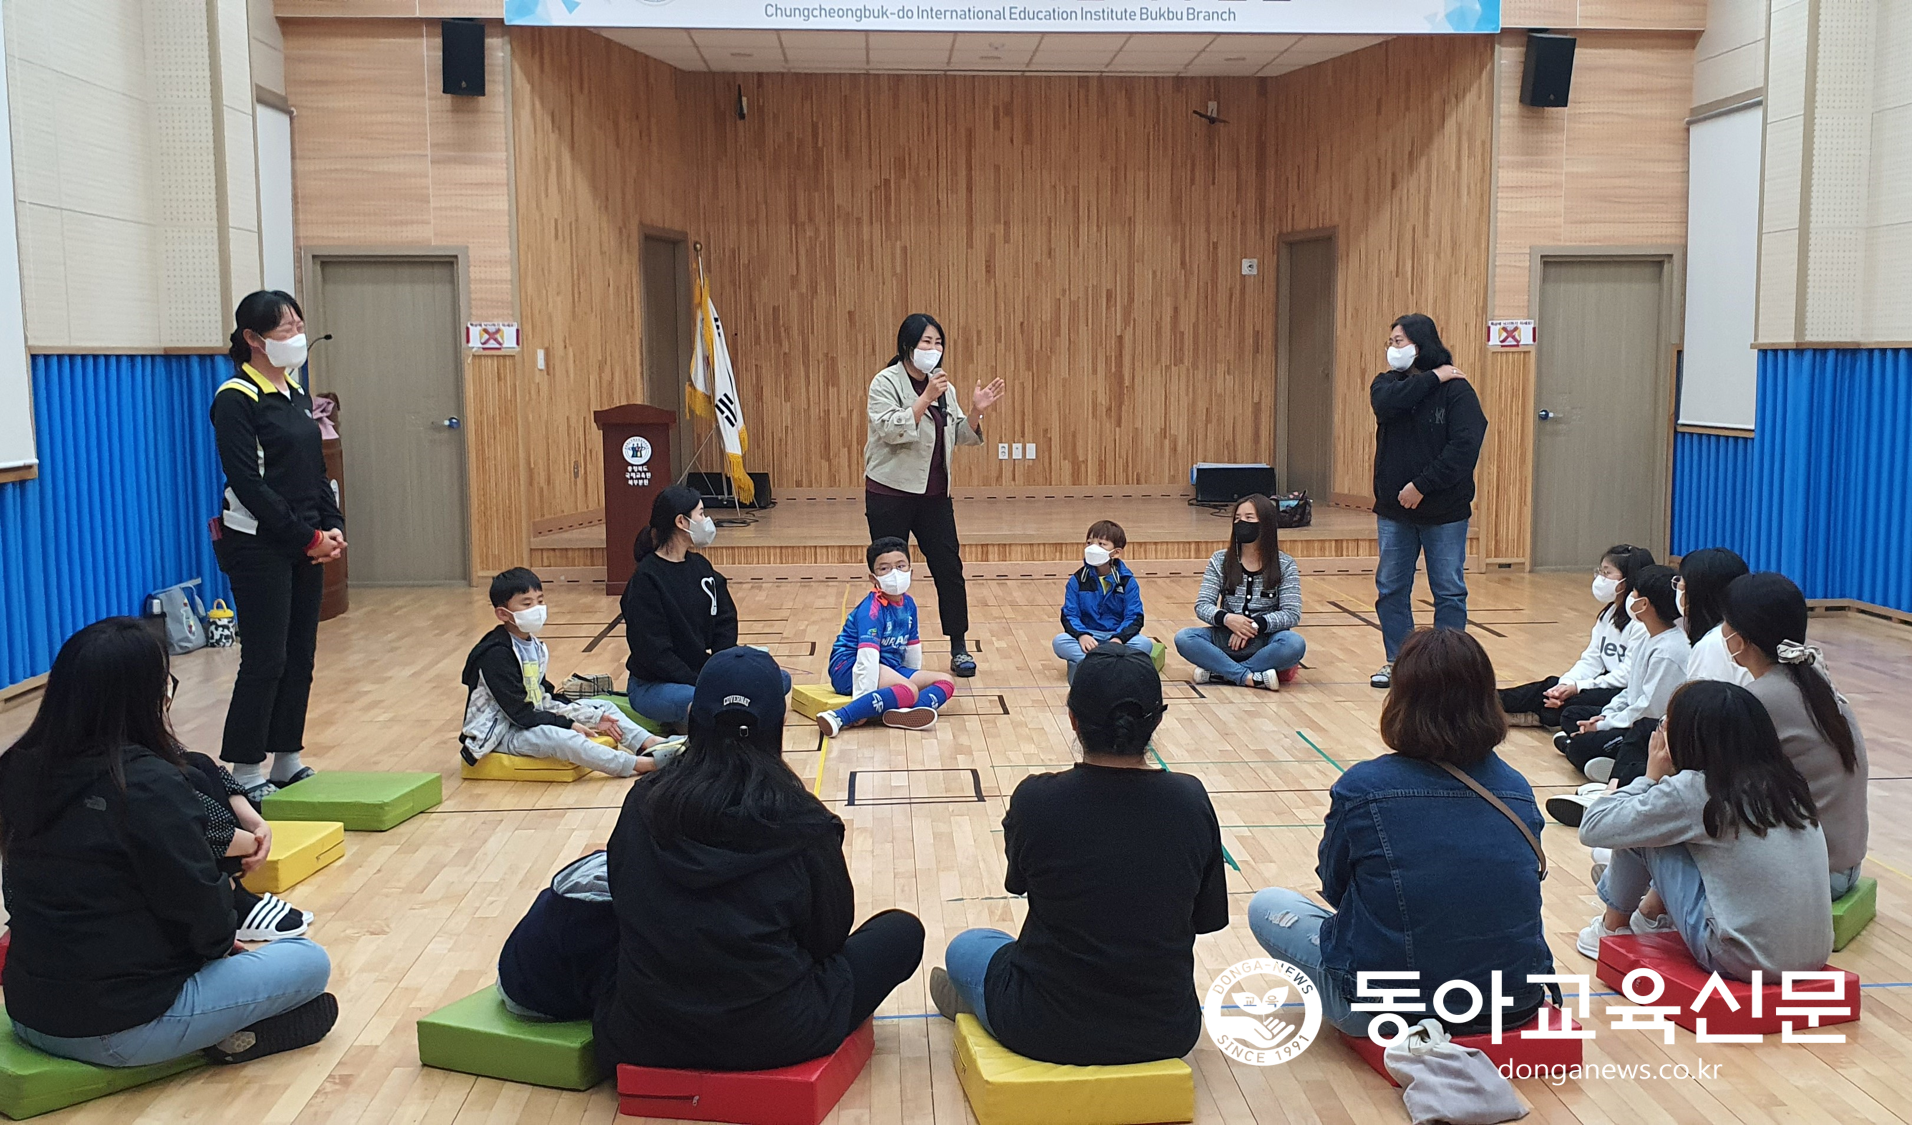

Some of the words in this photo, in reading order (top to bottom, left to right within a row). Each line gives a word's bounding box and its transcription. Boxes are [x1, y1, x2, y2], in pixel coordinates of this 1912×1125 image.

[764, 3, 914, 22] Chungcheongbuk-do
[916, 5, 1007, 21] International
[1009, 6, 1078, 21] Education
[1080, 6, 1137, 21] Institute
[1139, 6, 1184, 21] Bukbu
[1186, 7, 1236, 22] Branch
